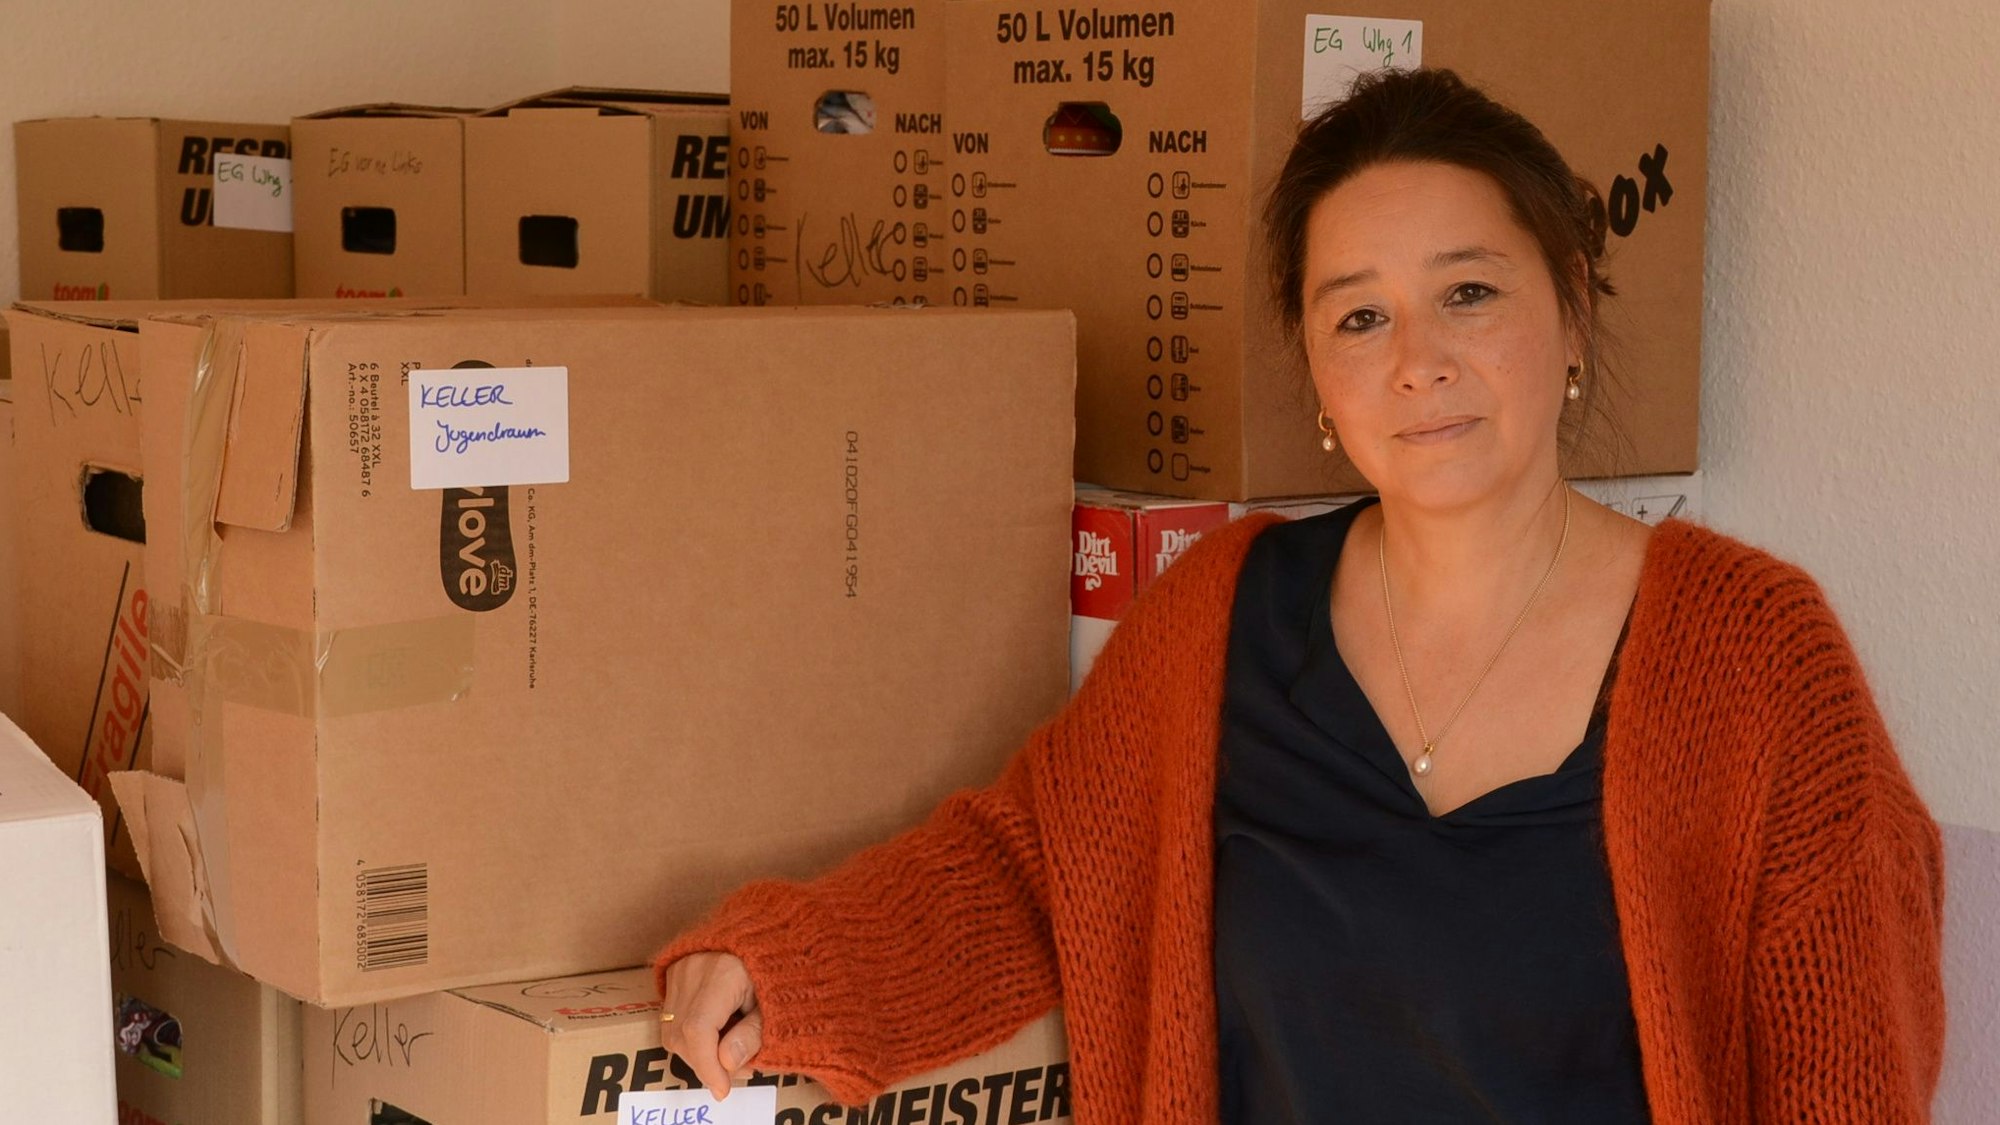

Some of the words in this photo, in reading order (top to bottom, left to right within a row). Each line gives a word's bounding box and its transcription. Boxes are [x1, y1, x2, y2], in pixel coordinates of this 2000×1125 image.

[776, 5, 799, 31] 50
[807, 4, 818, 31] L
[824, 3, 915, 31] Volumen
[997, 12, 1027, 43] 50
[1036, 11, 1050, 41] L
[1058, 8, 1174, 40] Volumen
[788, 46, 835, 68] max.
[843, 41, 867, 68] 15
[875, 40, 899, 74] kg
[1314, 27, 1343, 53] EG
[1363, 26, 1394, 67] Whg
[1401, 30, 1412, 53] 1
[1013, 59, 1072, 84] max.
[1083, 51, 1113, 81] 15
[1123, 49, 1154, 87] kg
[740, 111, 768, 130] VON
[895, 114, 941, 133] NACH
[953, 133, 988, 153] VON
[1149, 131, 1207, 153] NACH
[218, 162, 244, 182] EG
[401, 362, 410, 386] XXL
[360, 387, 369, 395] 4
[370, 375, 380, 410] Beutel
[421, 384, 513, 408] KELLER
[349, 415, 359, 453] 50657
[360, 398, 370, 442] 058172
[371, 425, 380, 440] 32
[436, 420, 546, 454] Jugendraum
[361, 447, 371, 485] 68487
[372, 444, 381, 468] XXL
[527, 505, 535, 522] KG,
[1078, 530, 1111, 557] Dirt
[527, 544, 537, 585] dm-Platz
[1075, 551, 1119, 580] Devil
[528, 646, 537, 690] Karlsruhe
[356, 874, 367, 918] 058172
[357, 925, 367, 969] 685002
[331, 1003, 433, 1089] Keller
[631, 1104, 714, 1125] KELLER
